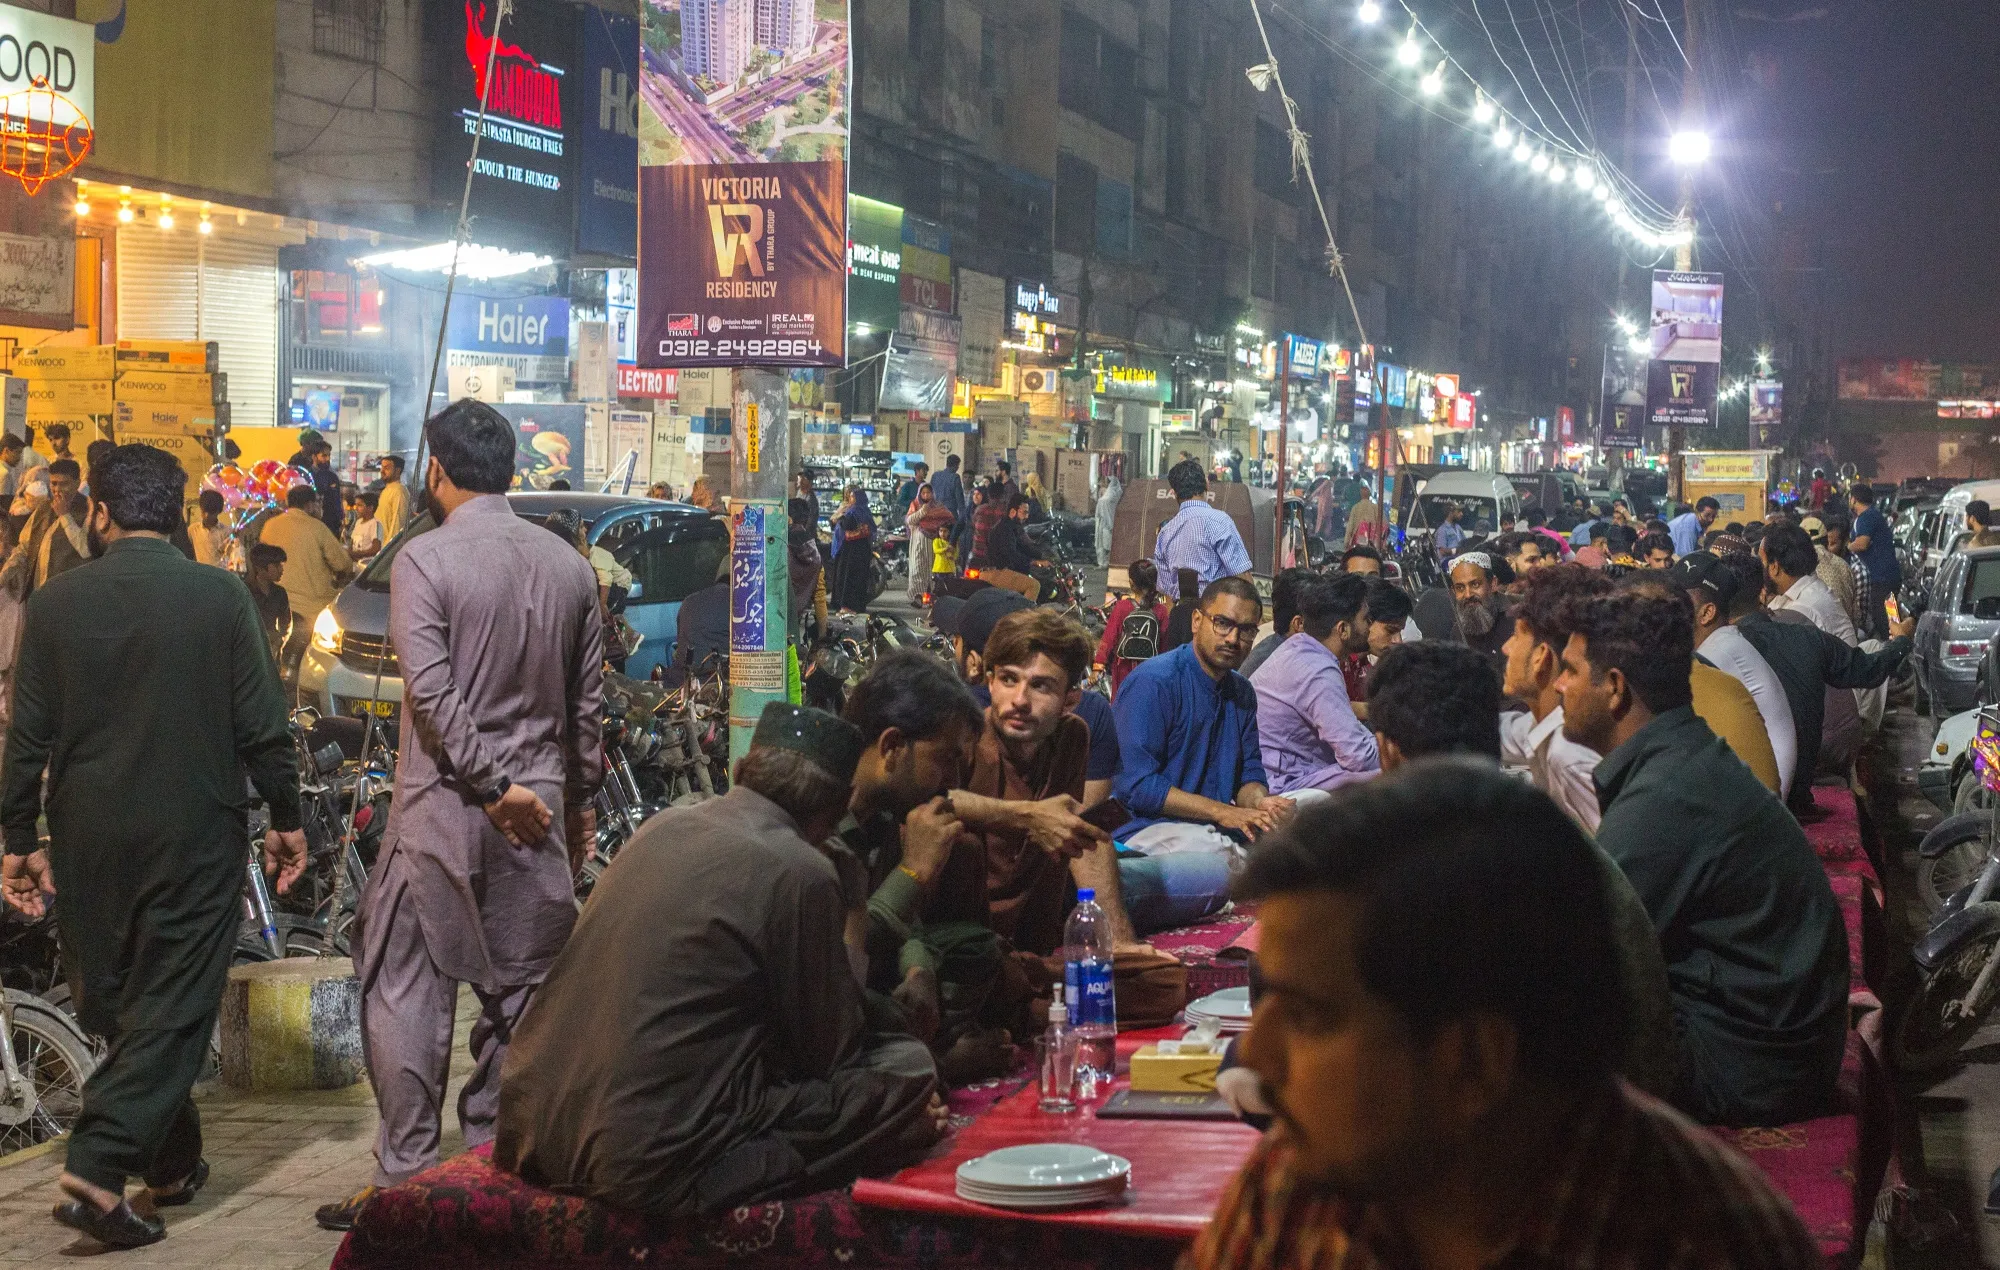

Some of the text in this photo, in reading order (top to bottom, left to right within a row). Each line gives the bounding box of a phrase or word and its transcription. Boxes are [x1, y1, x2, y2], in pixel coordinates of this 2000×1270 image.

[0, 34, 75, 92] OOD
[507, 165, 523, 182] THE
[525, 170, 559, 191] HUNGER
[701, 176, 782, 200] VICTORIA
[766, 209, 775, 272] BY THARA GROUP
[853, 243, 880, 266] meat
[706, 281, 778, 298] RESIDENCY
[912, 277, 938, 307] TCL
[478, 300, 549, 345] Haier
[659, 340, 822, 357] 0312-2492964
[18, 358, 66, 368] KENWOOD
[617, 370, 663, 394] LECTRO
[683, 369, 710, 379] Haier
[28, 390, 55, 399] WOOD
[120, 381, 166, 391] KENWOOD
[152, 412, 179, 422] Haier
[658, 432, 687, 444] Haier
[1156, 488, 1216, 502] SAR
